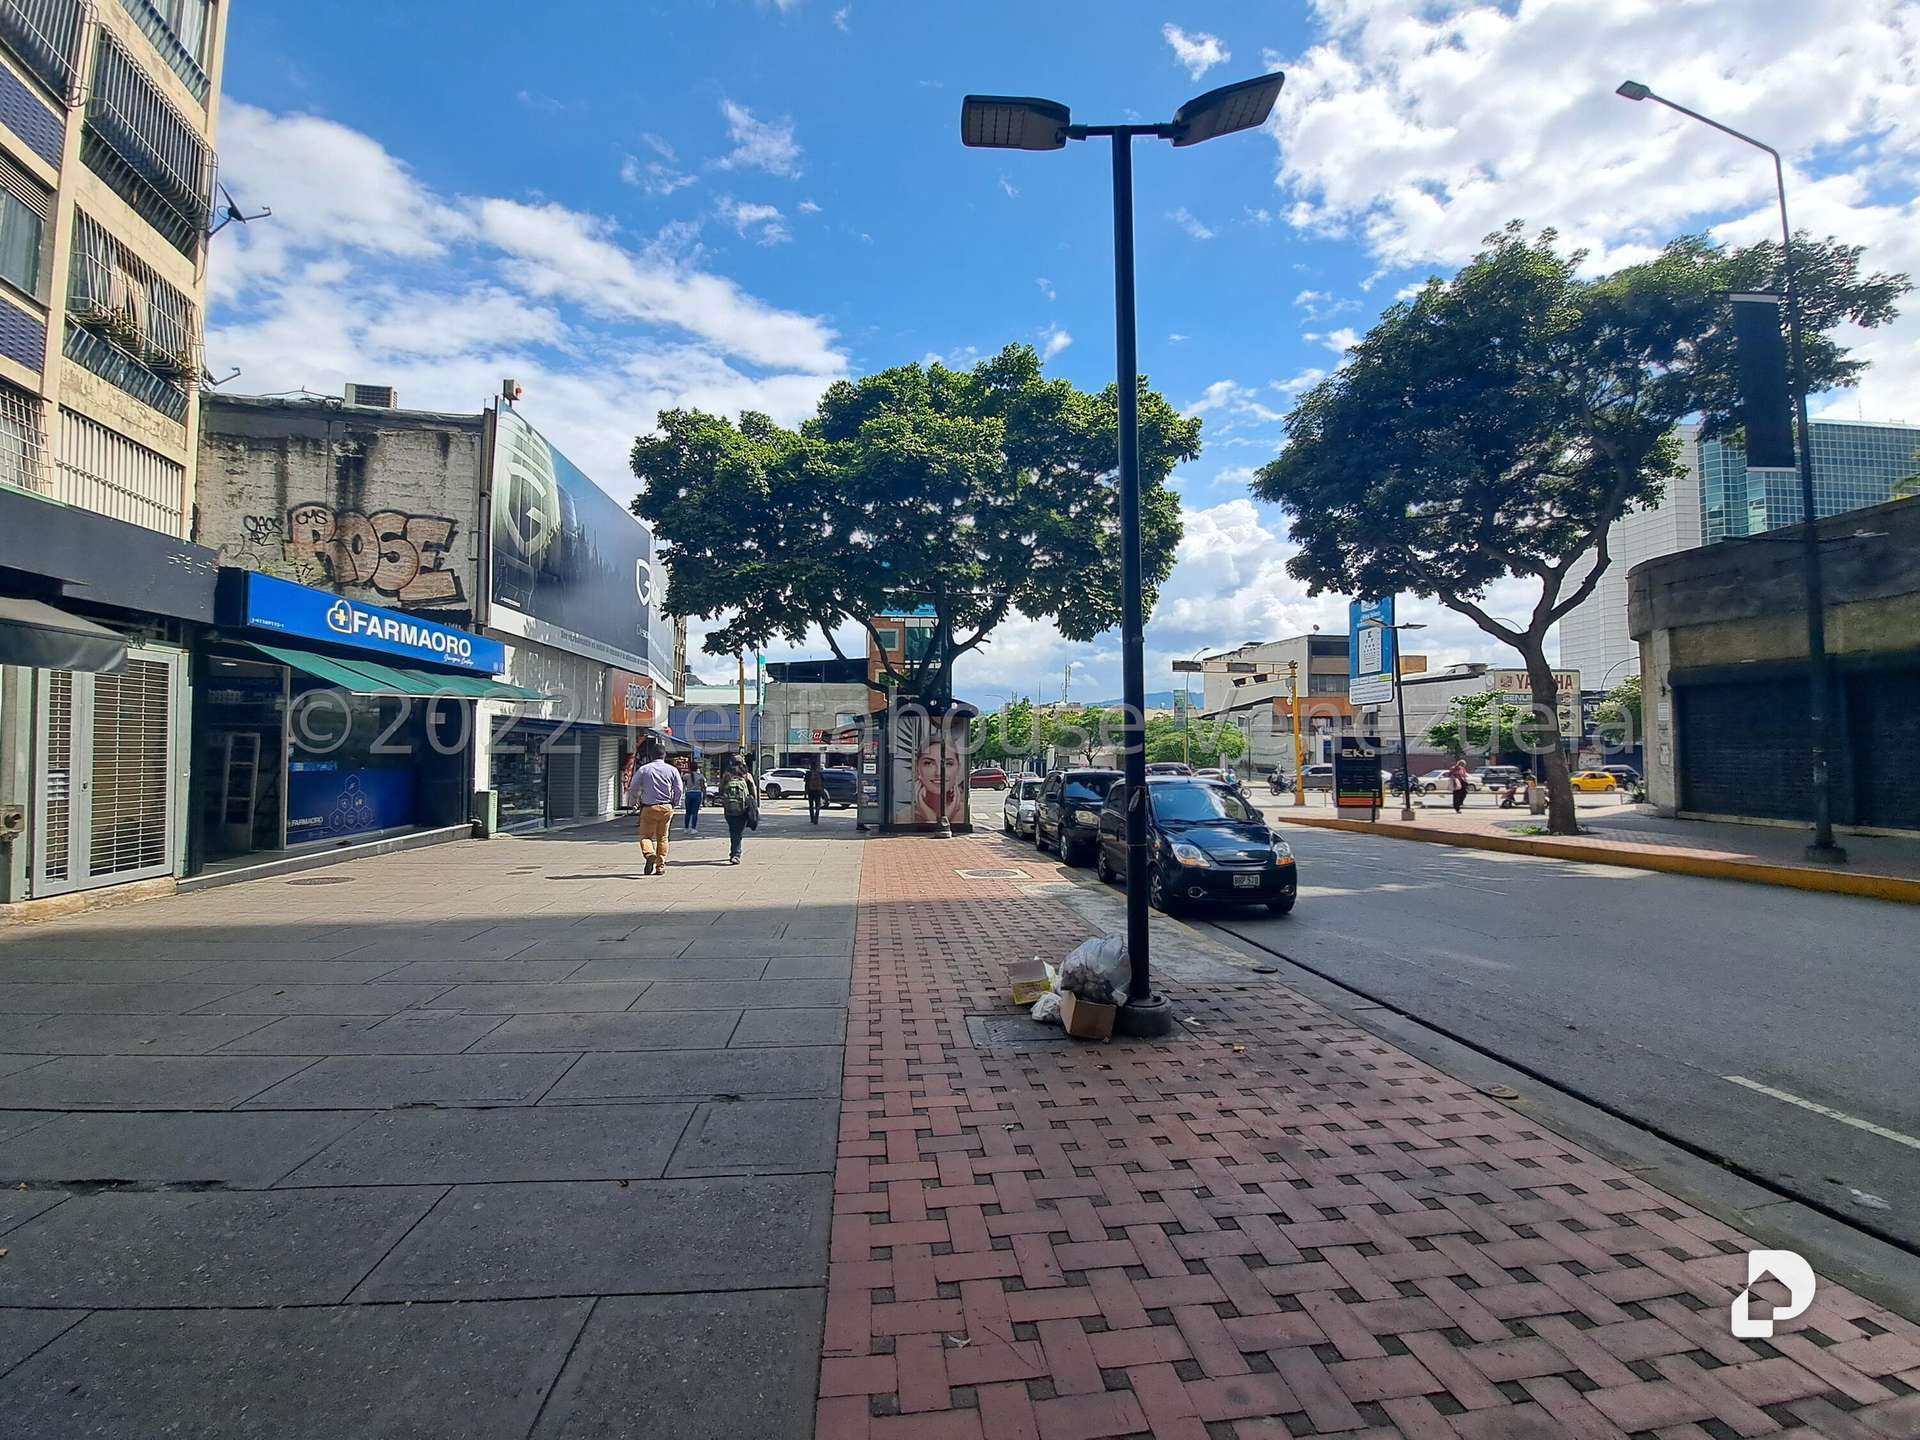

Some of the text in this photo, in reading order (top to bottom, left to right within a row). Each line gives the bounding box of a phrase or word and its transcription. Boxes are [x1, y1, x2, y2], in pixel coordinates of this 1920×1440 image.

[281, 502, 467, 604] ROSE
[353, 611, 472, 657] FARMAORO
[1516, 674, 1573, 690] YAHA
[1342, 748, 1376, 758] EKO
